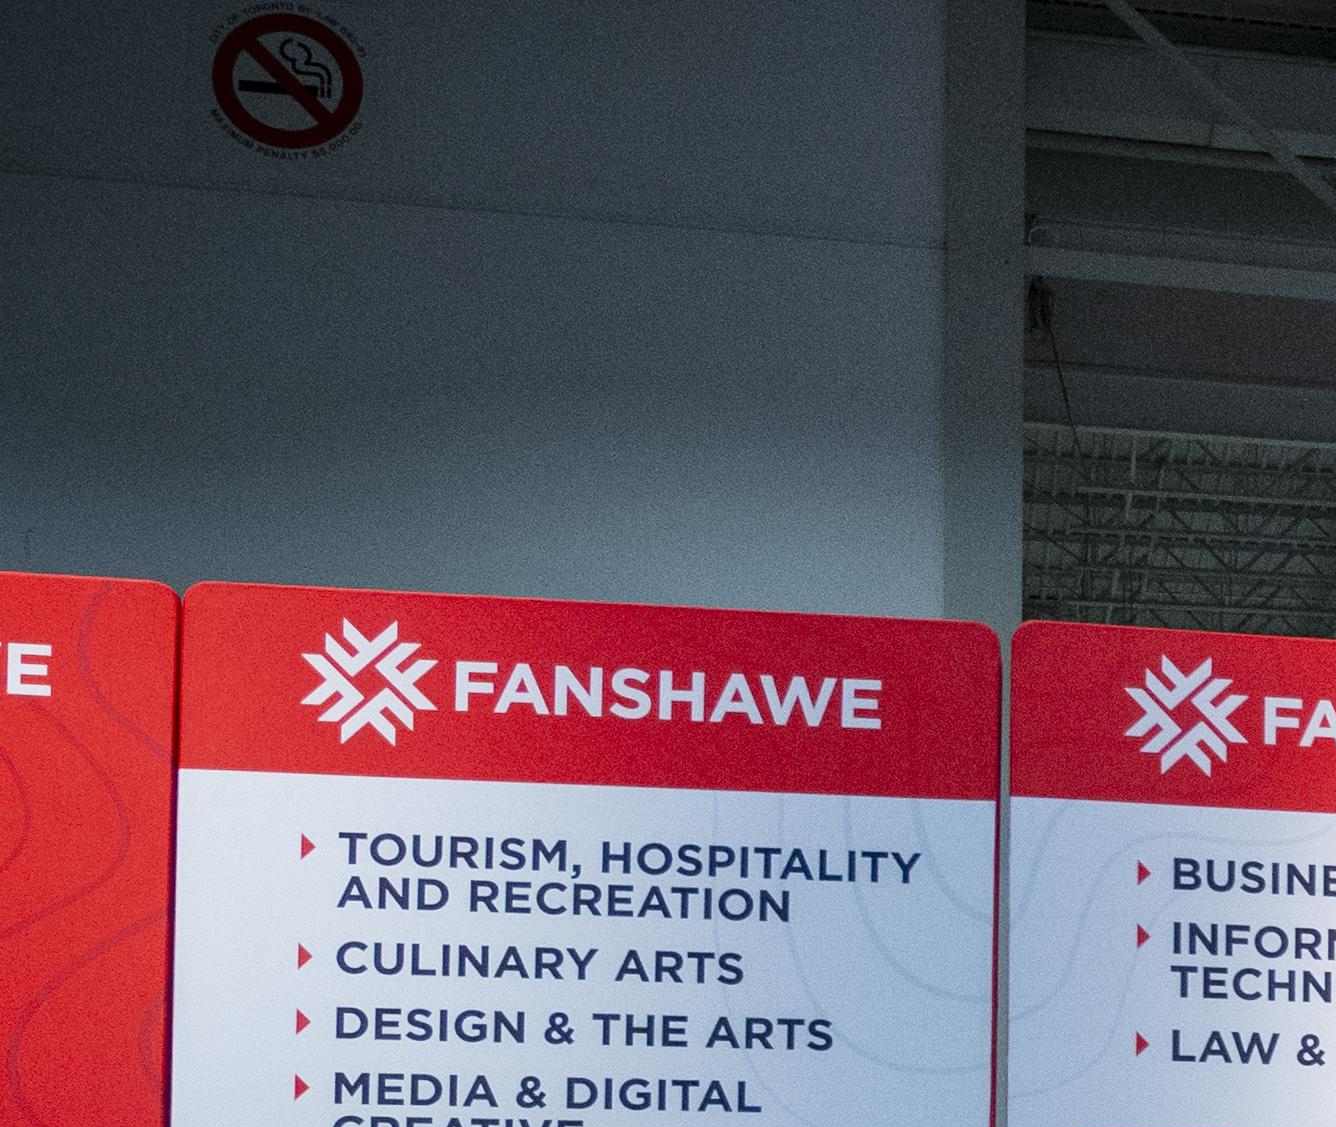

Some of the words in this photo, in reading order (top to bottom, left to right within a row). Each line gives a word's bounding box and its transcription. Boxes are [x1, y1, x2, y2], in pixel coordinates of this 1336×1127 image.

[455, 661, 881, 729] FANSHAWE
[339, 832, 581, 879] TOURISM,
[602, 842, 921, 883] HOSPITALITY
[338, 876, 448, 910] AND
[470, 880, 789, 922] RECREATION
[337, 942, 598, 980] CULINARY
[616, 950, 743, 985] ARTS
[336, 1007, 524, 1043] DESIGN
[545, 1012, 574, 1044] &
[593, 1014, 688, 1047] THE
[706, 1017, 832, 1051] ARTS
[1172, 1030, 1279, 1064] LAW
[1297, 1034, 1325, 1066] &
[335, 1073, 498, 1107] MEDIA
[516, 1076, 546, 1108] &
[567, 1078, 761, 1112] DIGITAL
